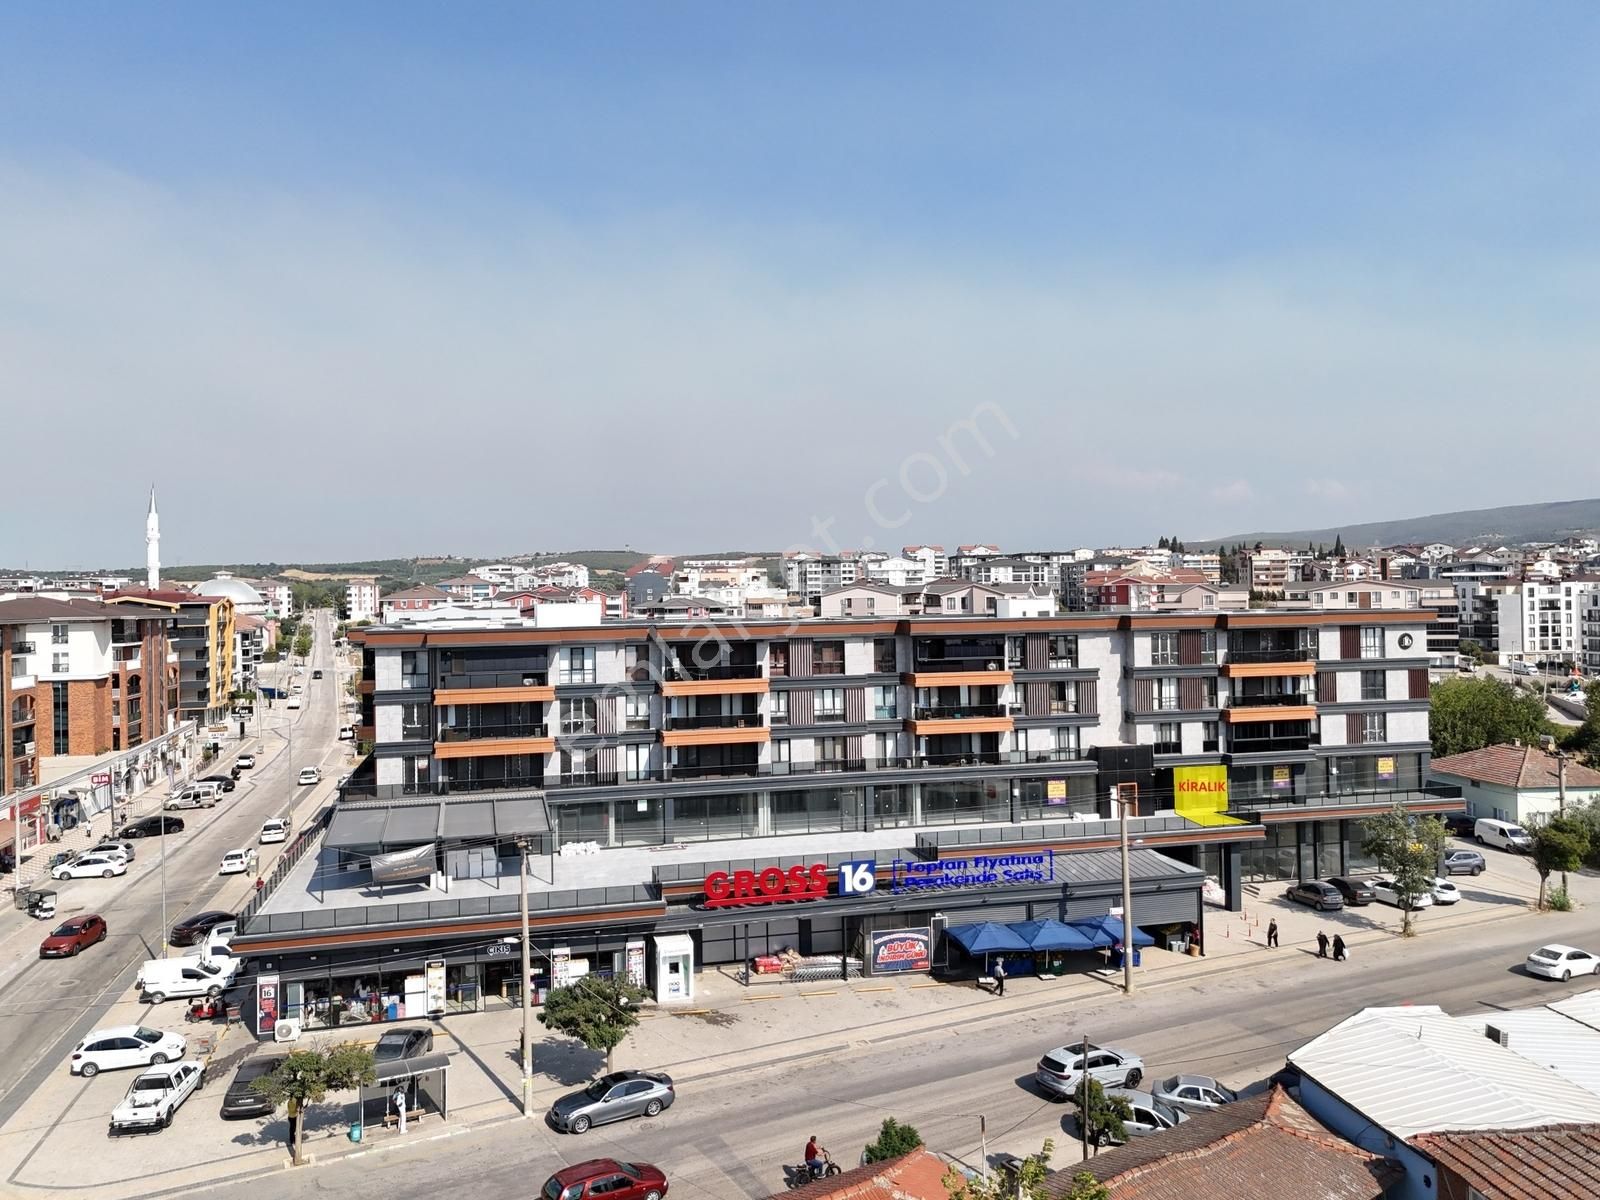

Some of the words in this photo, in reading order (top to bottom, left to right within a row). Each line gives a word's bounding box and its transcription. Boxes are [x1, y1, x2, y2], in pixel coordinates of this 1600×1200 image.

[905, 859, 968, 875] Toptan
[704, 863, 829, 900] GROSS
[841, 864, 875, 893] 16
[904, 871, 998, 887] Perakende
